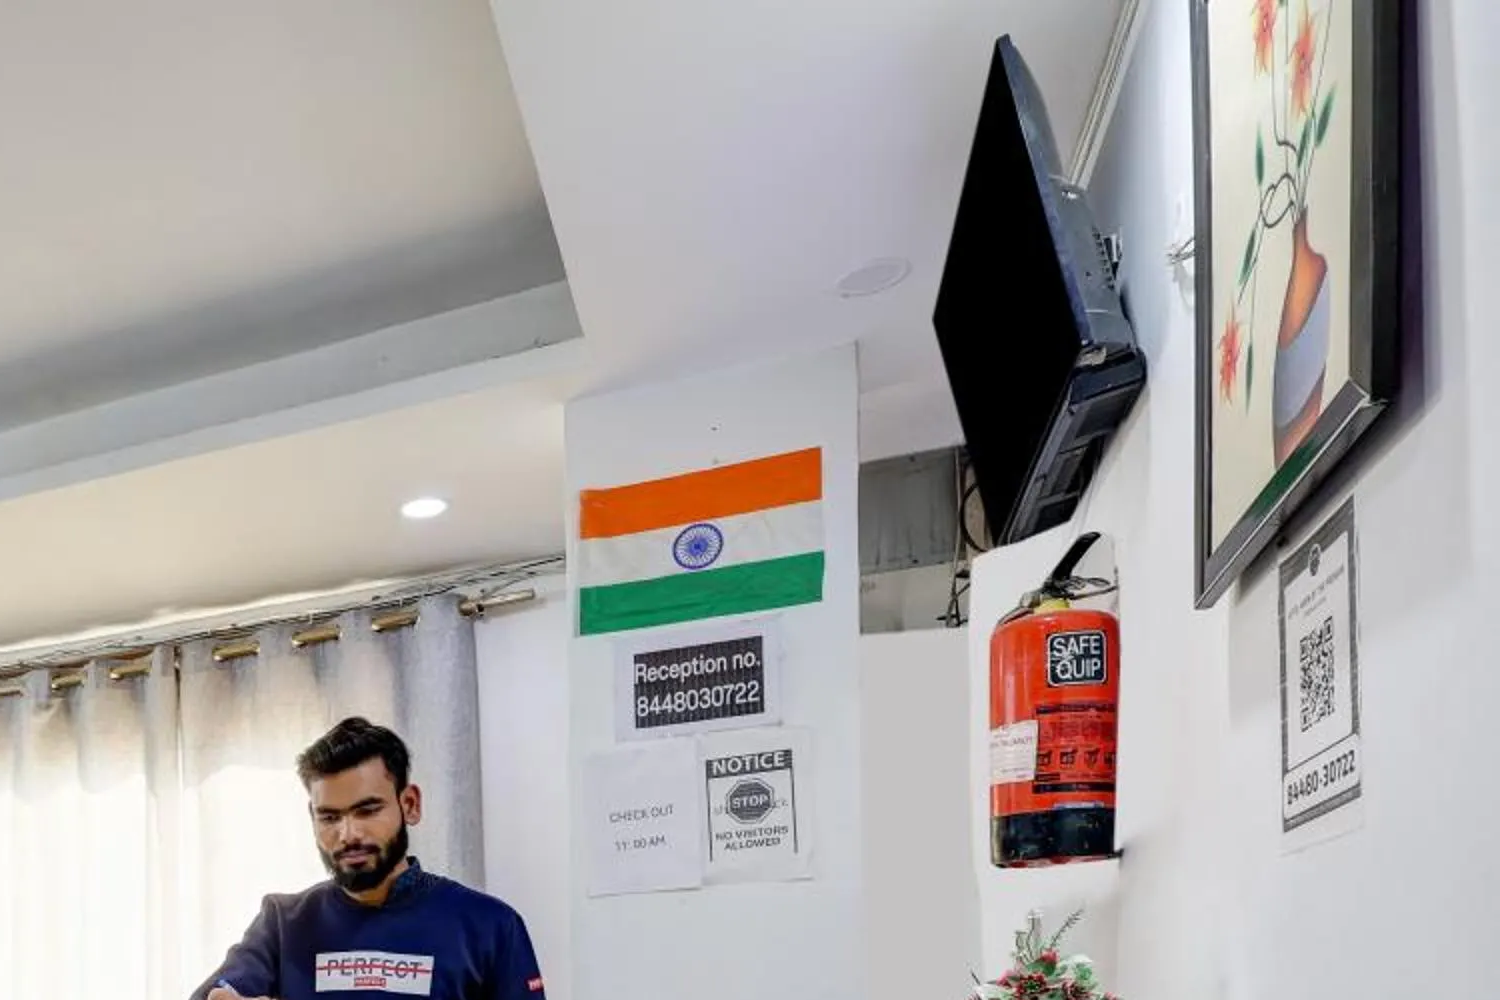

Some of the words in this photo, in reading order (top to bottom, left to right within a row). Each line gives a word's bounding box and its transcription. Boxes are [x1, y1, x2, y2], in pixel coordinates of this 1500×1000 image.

[1053, 635, 1101, 656] SAFE
[635, 654, 727, 684] Reception
[732, 651, 760, 670] no.
[1056, 658, 1101, 680] QUIP
[637, 680, 759, 717] 8448030722
[712, 751, 785, 776] NOTICE
[731, 794, 769, 809] STOP
[609, 808, 649, 823] CHECK
[650, 803, 674, 818] OUT
[648, 834, 667, 848] AM
[715, 831, 733, 841] NO
[735, 825, 789, 839] VISITORS
[724, 837, 782, 851] ALLOWED
